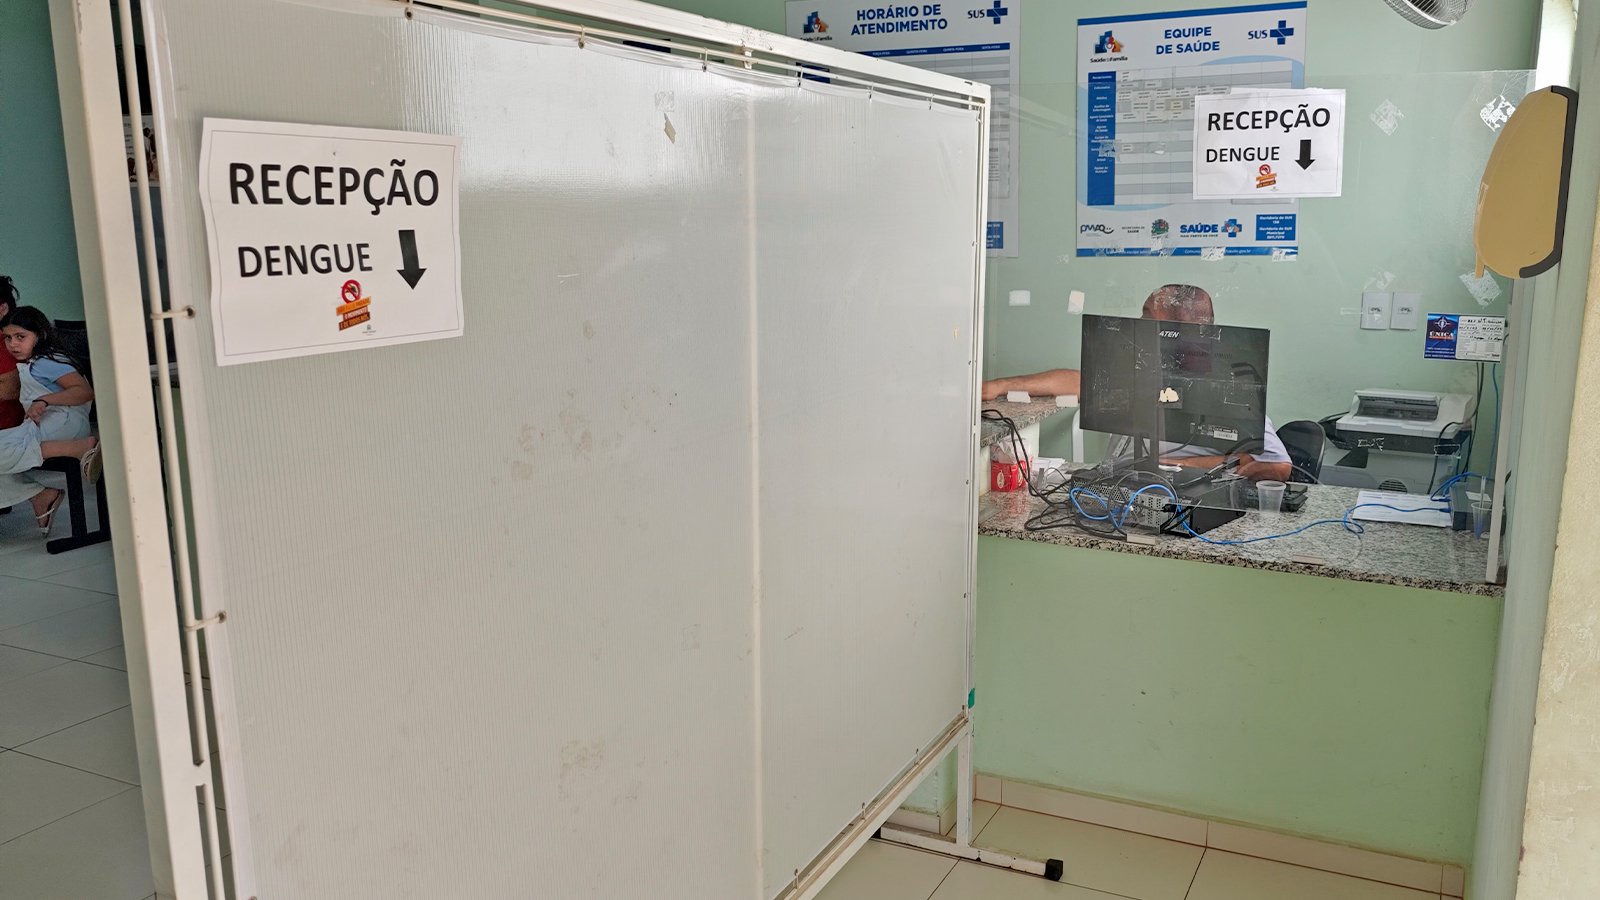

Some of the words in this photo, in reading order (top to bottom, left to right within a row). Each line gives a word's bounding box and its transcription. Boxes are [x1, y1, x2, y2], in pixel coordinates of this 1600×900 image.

[856, 5, 921, 21] HORÁRIO
[922, 4, 942, 16] DE
[967, 9, 985, 19] SUS
[850, 18, 948, 36] ATENDIMENTO
[1164, 26, 1212, 39] EQUIPE
[1248, 30, 1268, 40] SUS
[1156, 44, 1173, 55] DE
[1176, 40, 1220, 54] SAÚDE
[1207, 103, 1331, 133] RECEPÇÃO
[1206, 146, 1280, 162] DENGUE
[229, 158, 440, 216] RECEPÇÃO
[1180, 222, 1219, 233] SAÚDE
[237, 243, 373, 278] DENGUE
